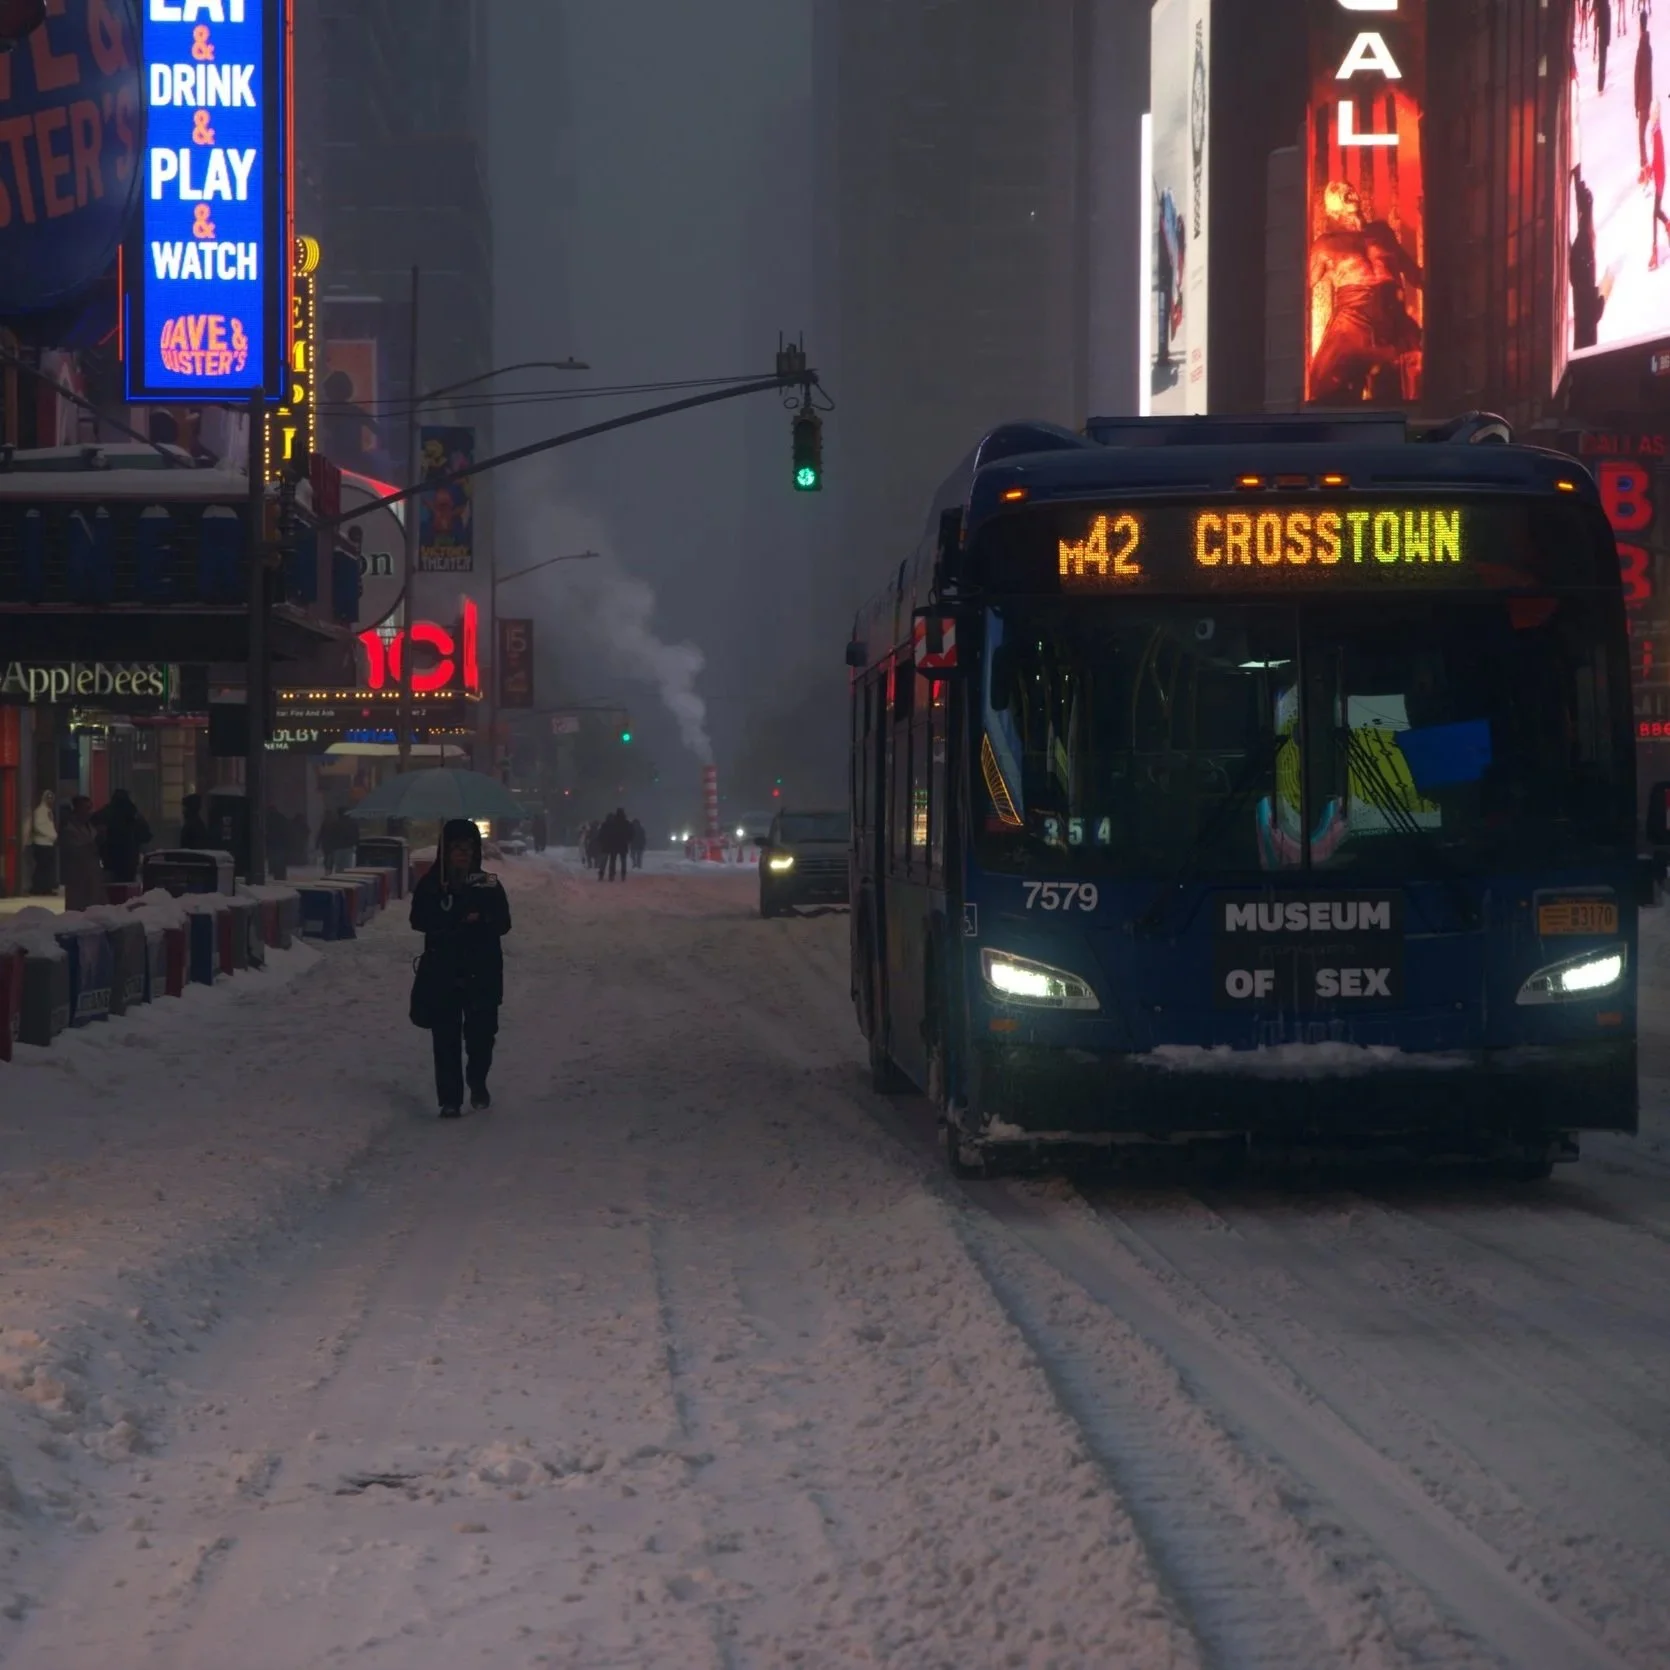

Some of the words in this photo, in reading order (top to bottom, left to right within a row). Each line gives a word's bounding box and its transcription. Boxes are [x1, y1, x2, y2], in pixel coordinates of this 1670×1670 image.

[191, 25, 214, 61] &
[150, 63, 256, 107] DRINK
[1335, 0, 1402, 146] AL
[192, 109, 215, 145] &
[0, 88, 134, 228] TER'S
[150, 148, 256, 200] PLAY
[192, 203, 216, 239] &
[151, 241, 257, 280] WATCH
[1058, 514, 1140, 576] M42
[1194, 510, 1461, 566] CROSSTOWN
[1022, 881, 1098, 911] 7579
[1225, 902, 1391, 931] MUSEUM
[1225, 969, 1275, 998] OF
[1315, 967, 1392, 997] SEX
